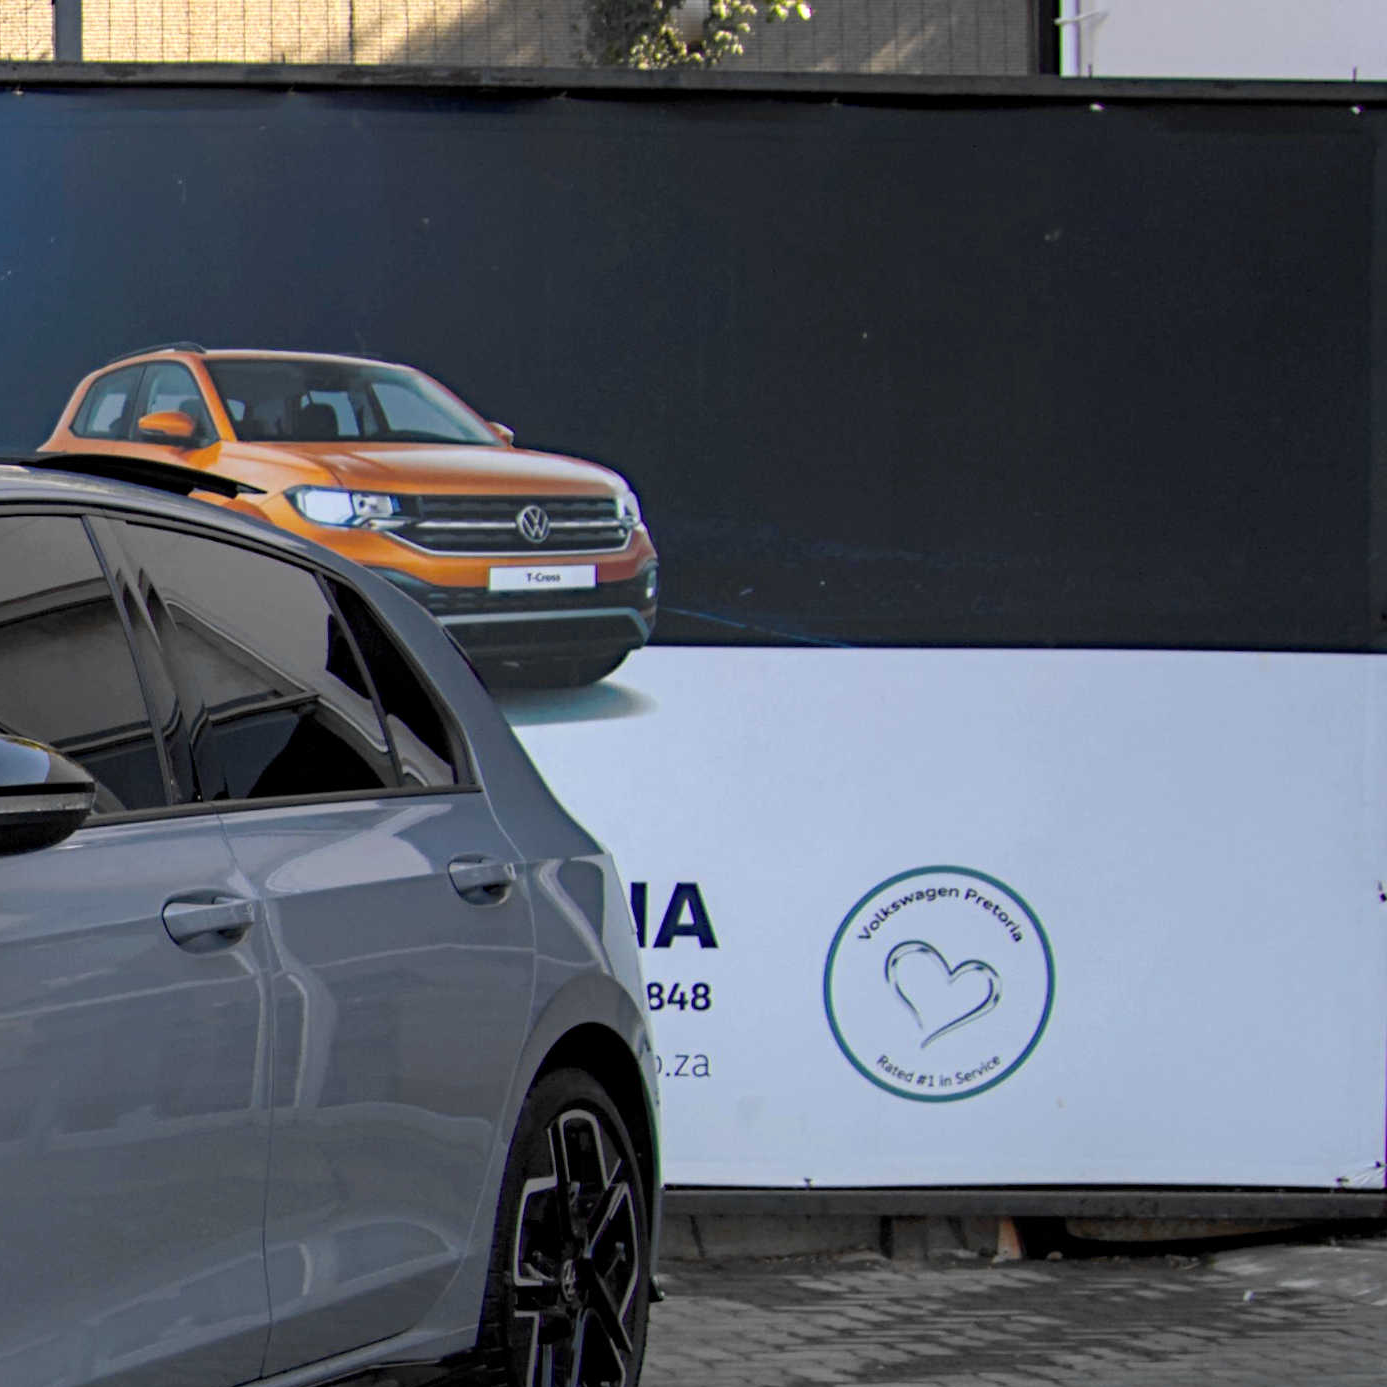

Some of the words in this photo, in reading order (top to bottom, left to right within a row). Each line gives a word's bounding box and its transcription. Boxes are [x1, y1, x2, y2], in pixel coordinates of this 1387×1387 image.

[526, 572, 561, 583] T-Cross
[858, 887, 960, 941] Volkswagen
[964, 888, 1024, 942] Pretoria
[647, 982, 711, 1011] 848
[656, 1053, 711, 1077] .za
[877, 1054, 915, 1083] Rated
[916, 1075, 934, 1087] #1
[939, 1074, 952, 1087] in
[955, 1055, 1001, 1085] Service
